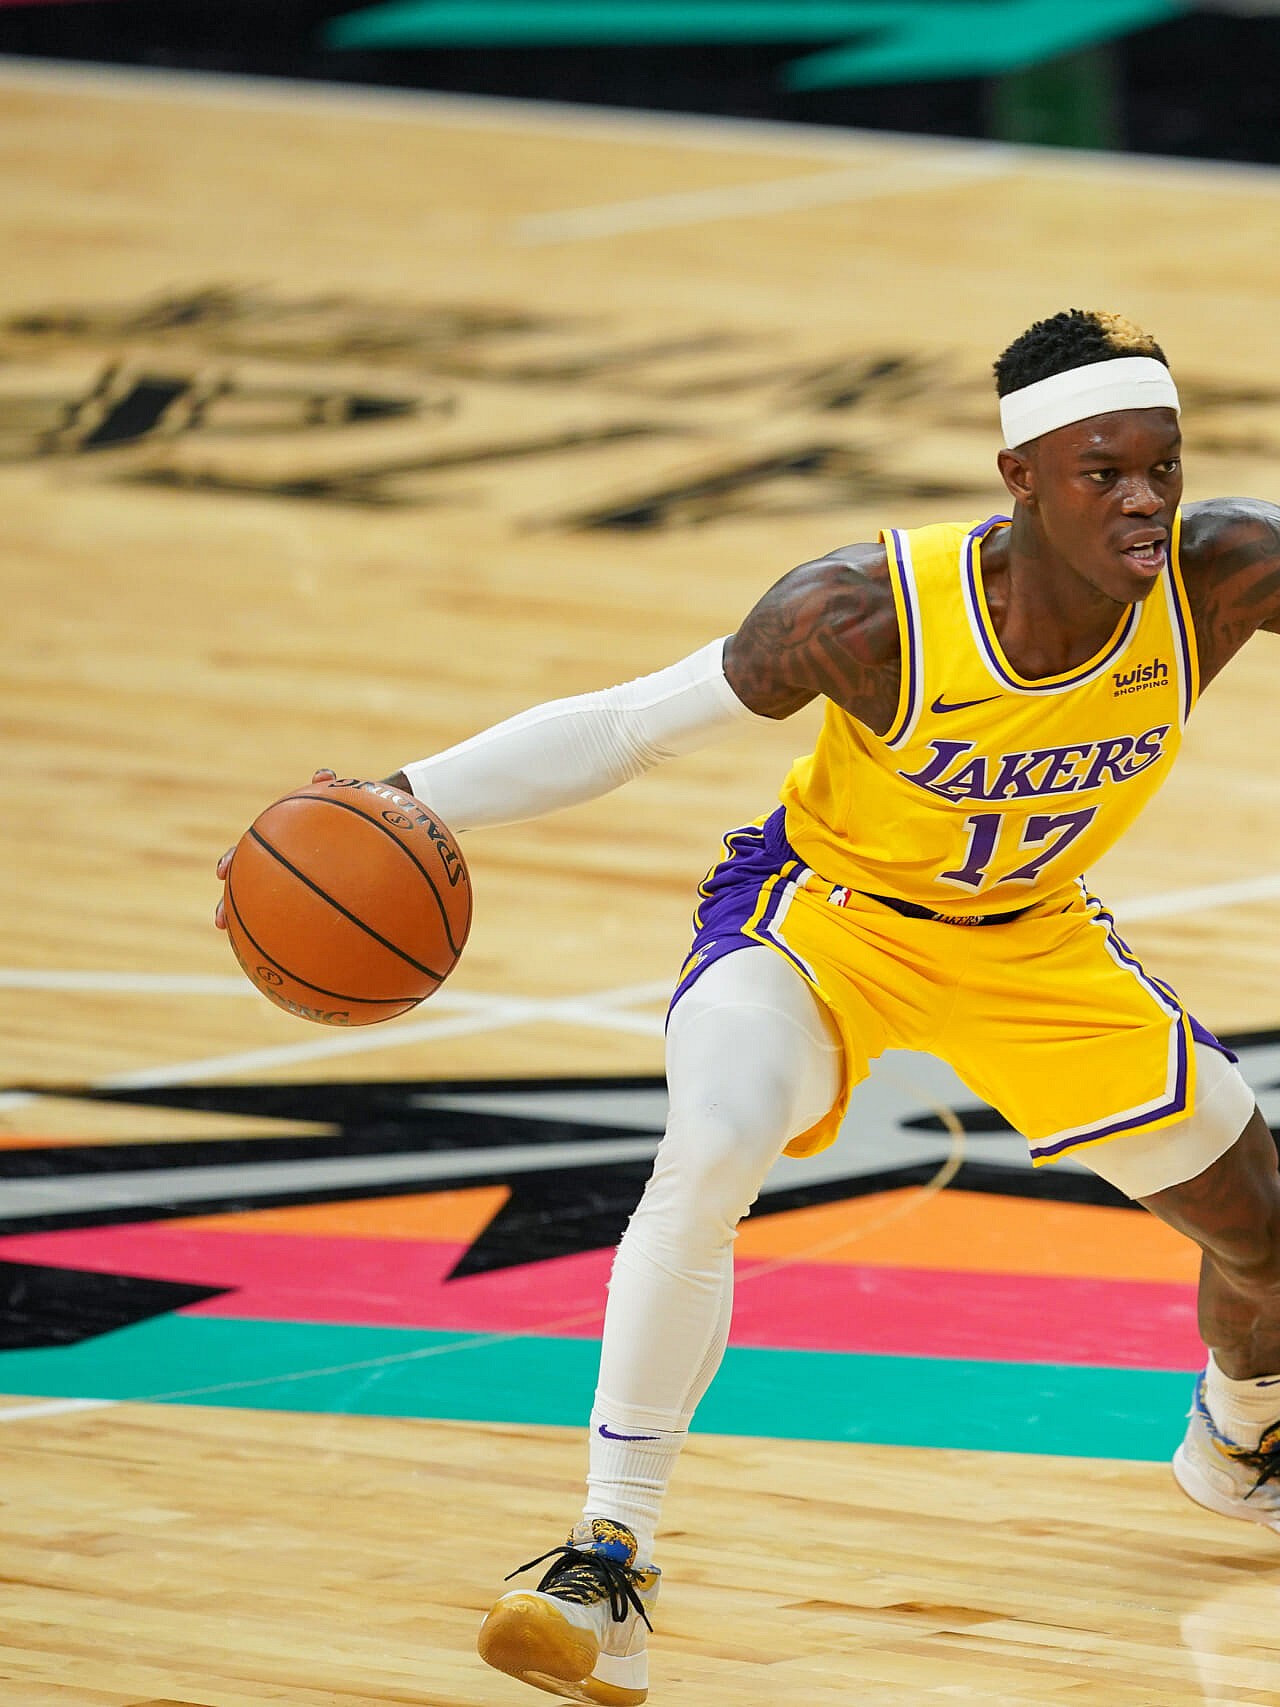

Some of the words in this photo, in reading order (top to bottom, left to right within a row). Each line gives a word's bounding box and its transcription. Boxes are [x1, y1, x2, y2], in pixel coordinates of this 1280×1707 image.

[1112, 658, 1168, 687] wish
[1113, 680, 1169, 697] SHOPPING
[896, 724, 1172, 804] LAKERS
[328, 778, 468, 887] SPALDING
[935, 804, 1103, 894] 17
